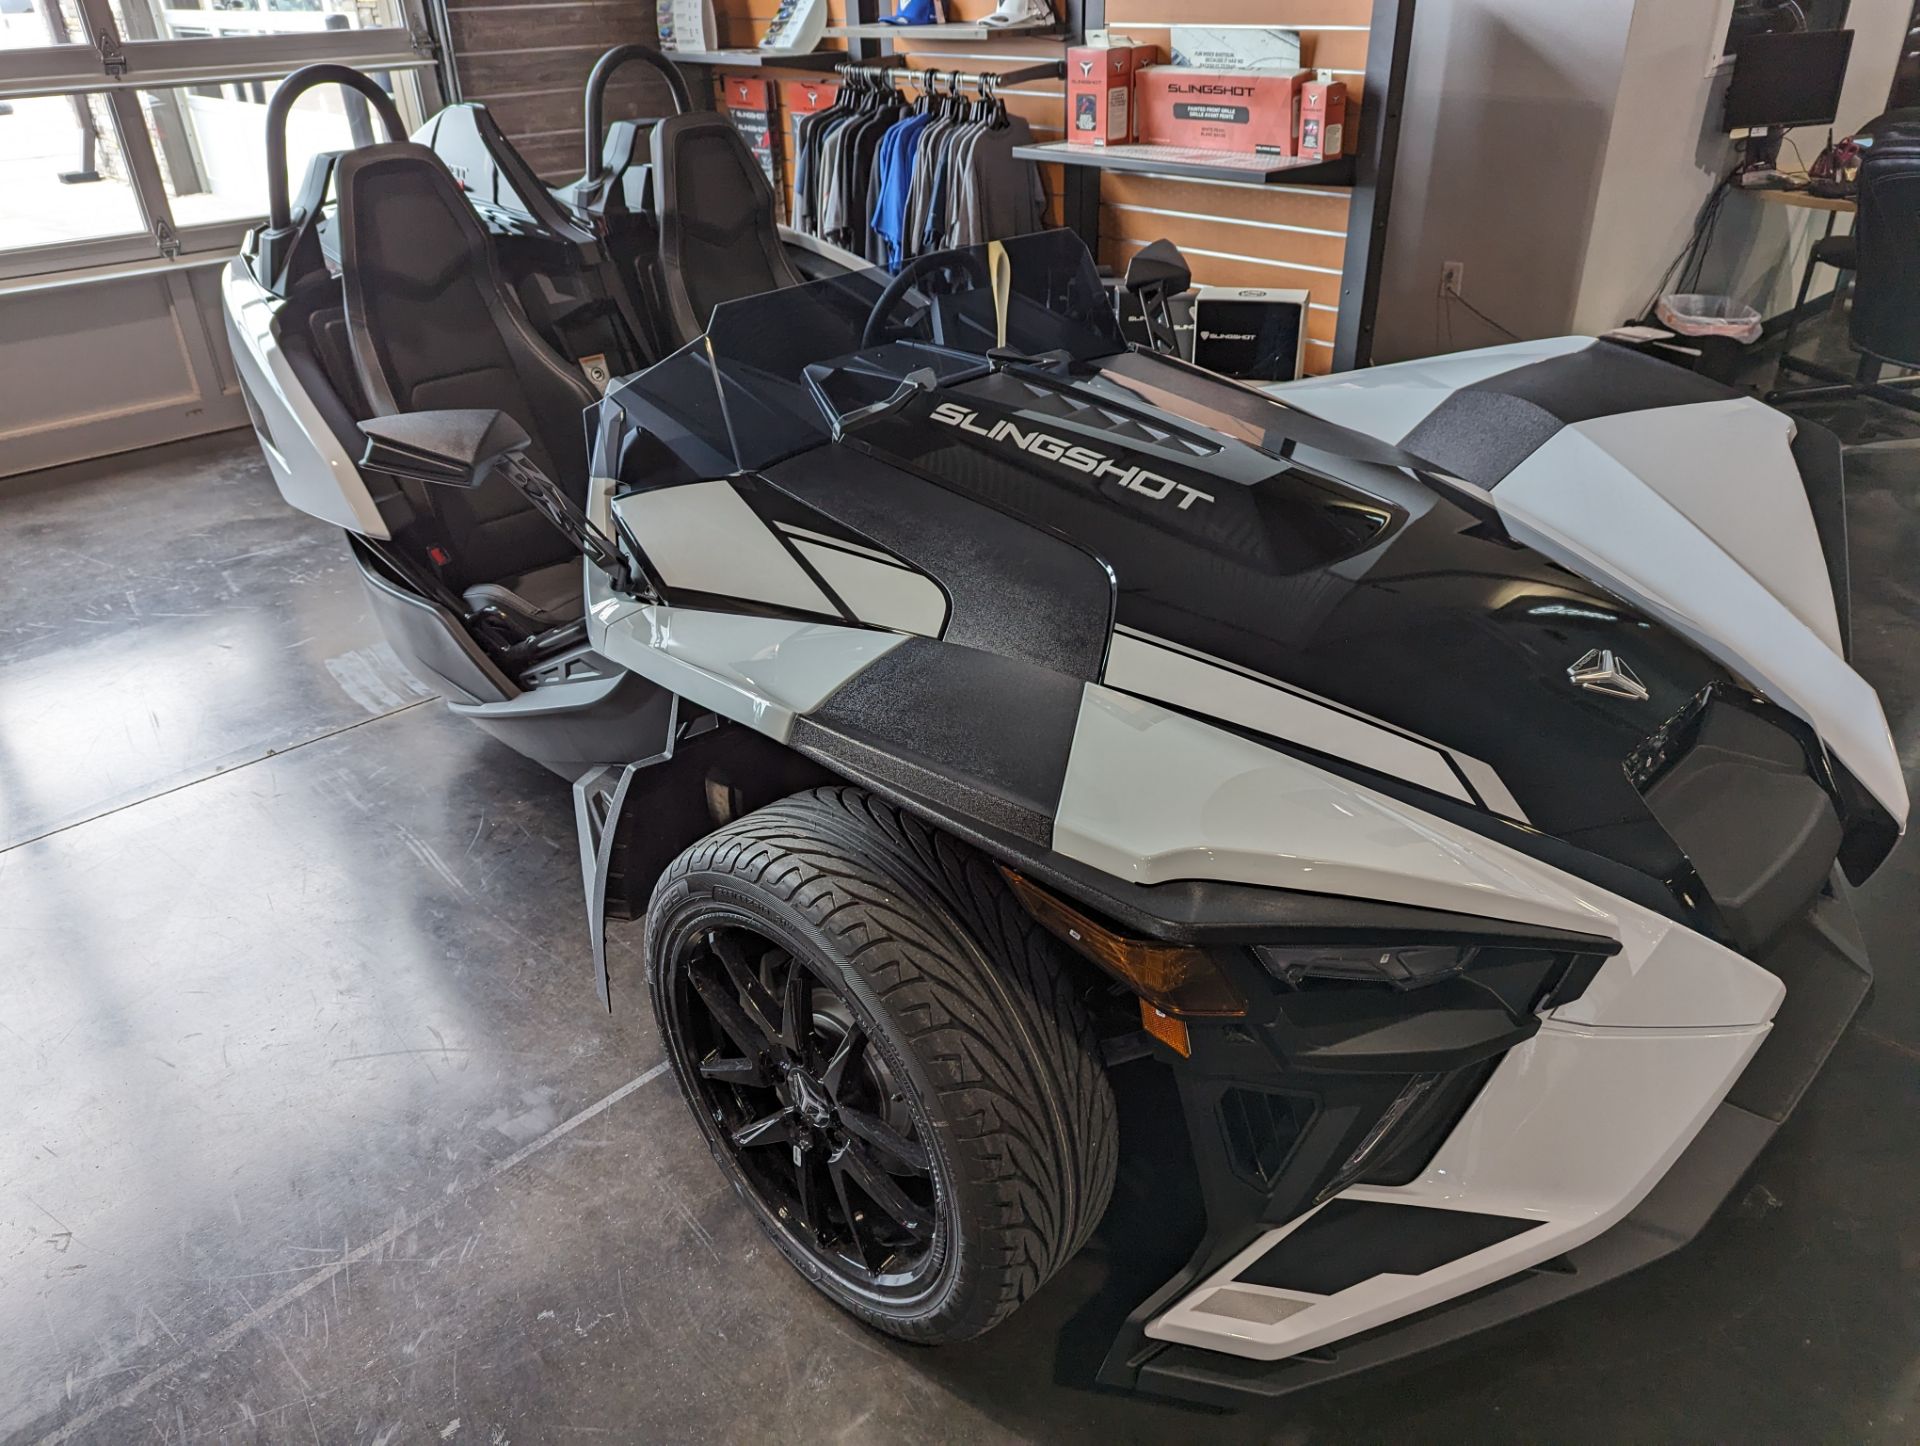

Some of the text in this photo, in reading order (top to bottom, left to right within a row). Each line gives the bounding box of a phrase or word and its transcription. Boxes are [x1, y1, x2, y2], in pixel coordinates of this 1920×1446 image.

[1168, 83, 1255, 97] SLINGSHOT
[1209, 333, 1257, 341] SLINGSHOT
[929, 402, 1215, 511] SLINGSHOT
